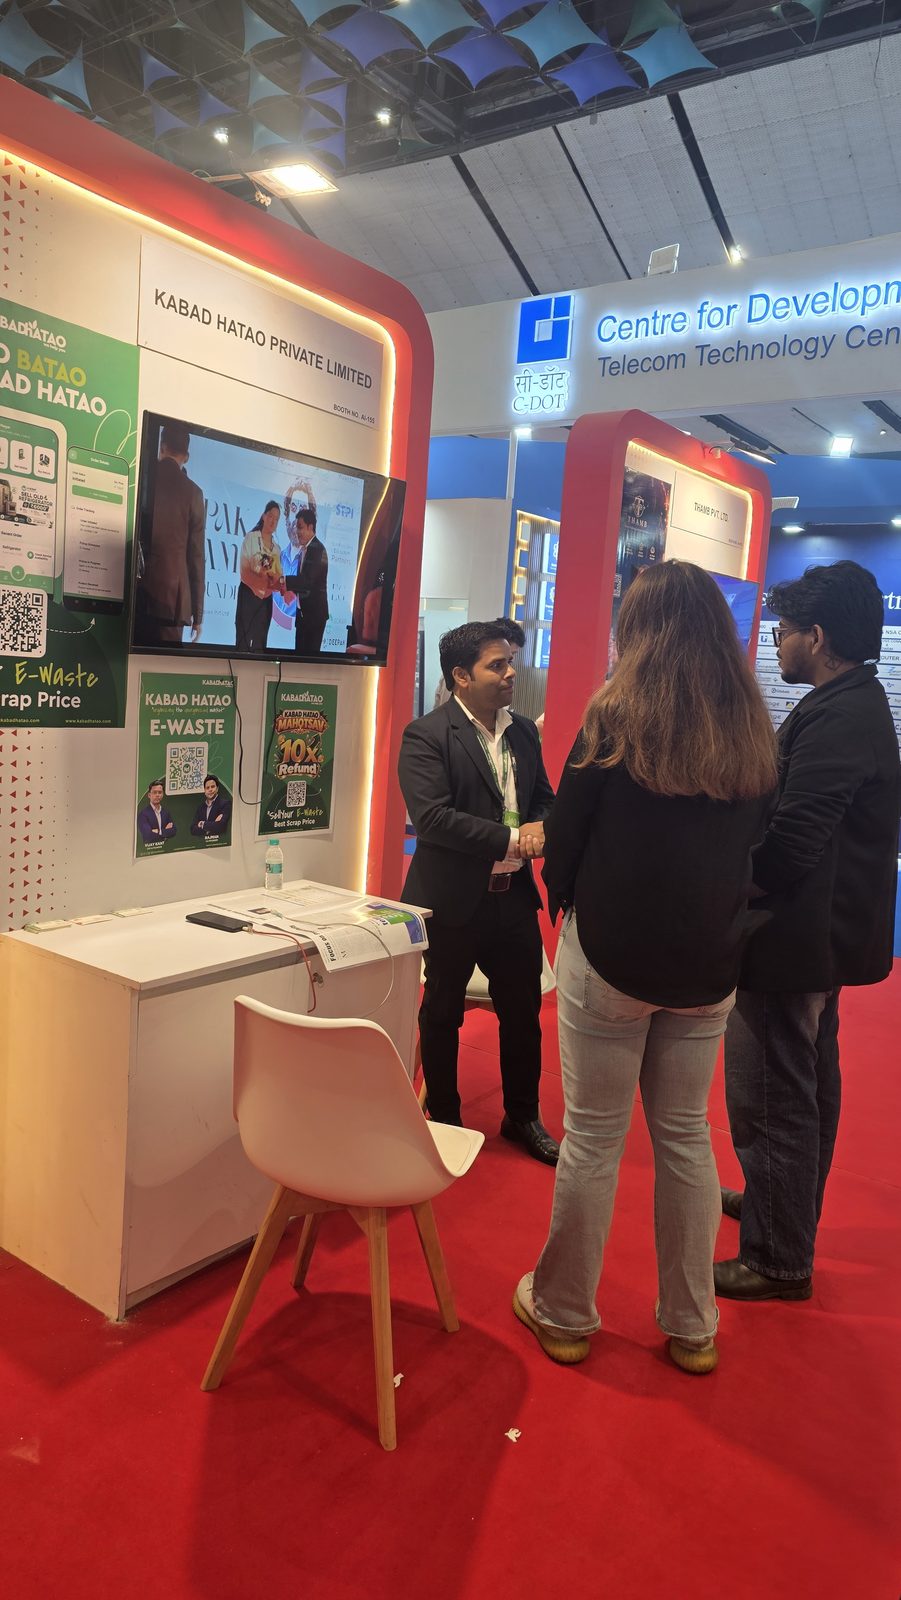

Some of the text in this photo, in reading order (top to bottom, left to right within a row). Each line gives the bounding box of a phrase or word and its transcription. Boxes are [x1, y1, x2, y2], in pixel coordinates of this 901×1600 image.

[597, 315, 687, 343] Centre
[697, 301, 738, 330] for
[154, 288, 373, 389] KABAD HATAO PRIVATE LIMITED
[598, 324, 901, 377] Telecom Technology Cen
[17, 348, 87, 387] BATAO
[515, 367, 566, 394] सी-डॉट
[37, 379, 107, 416] HATAO
[513, 393, 565, 412] C-DOT
[333, 403, 351, 416] BOOTH
[15, 661, 98, 688] E-Waste
[1, 690, 81, 711] rap Price
[145, 693, 232, 707] KABAD HATAO
[150, 718, 225, 736] E-WASTE
[277, 717, 325, 732] MAHOTSAV
[278, 763, 318, 776] Refund
[286, 819, 302, 827] Scrap
